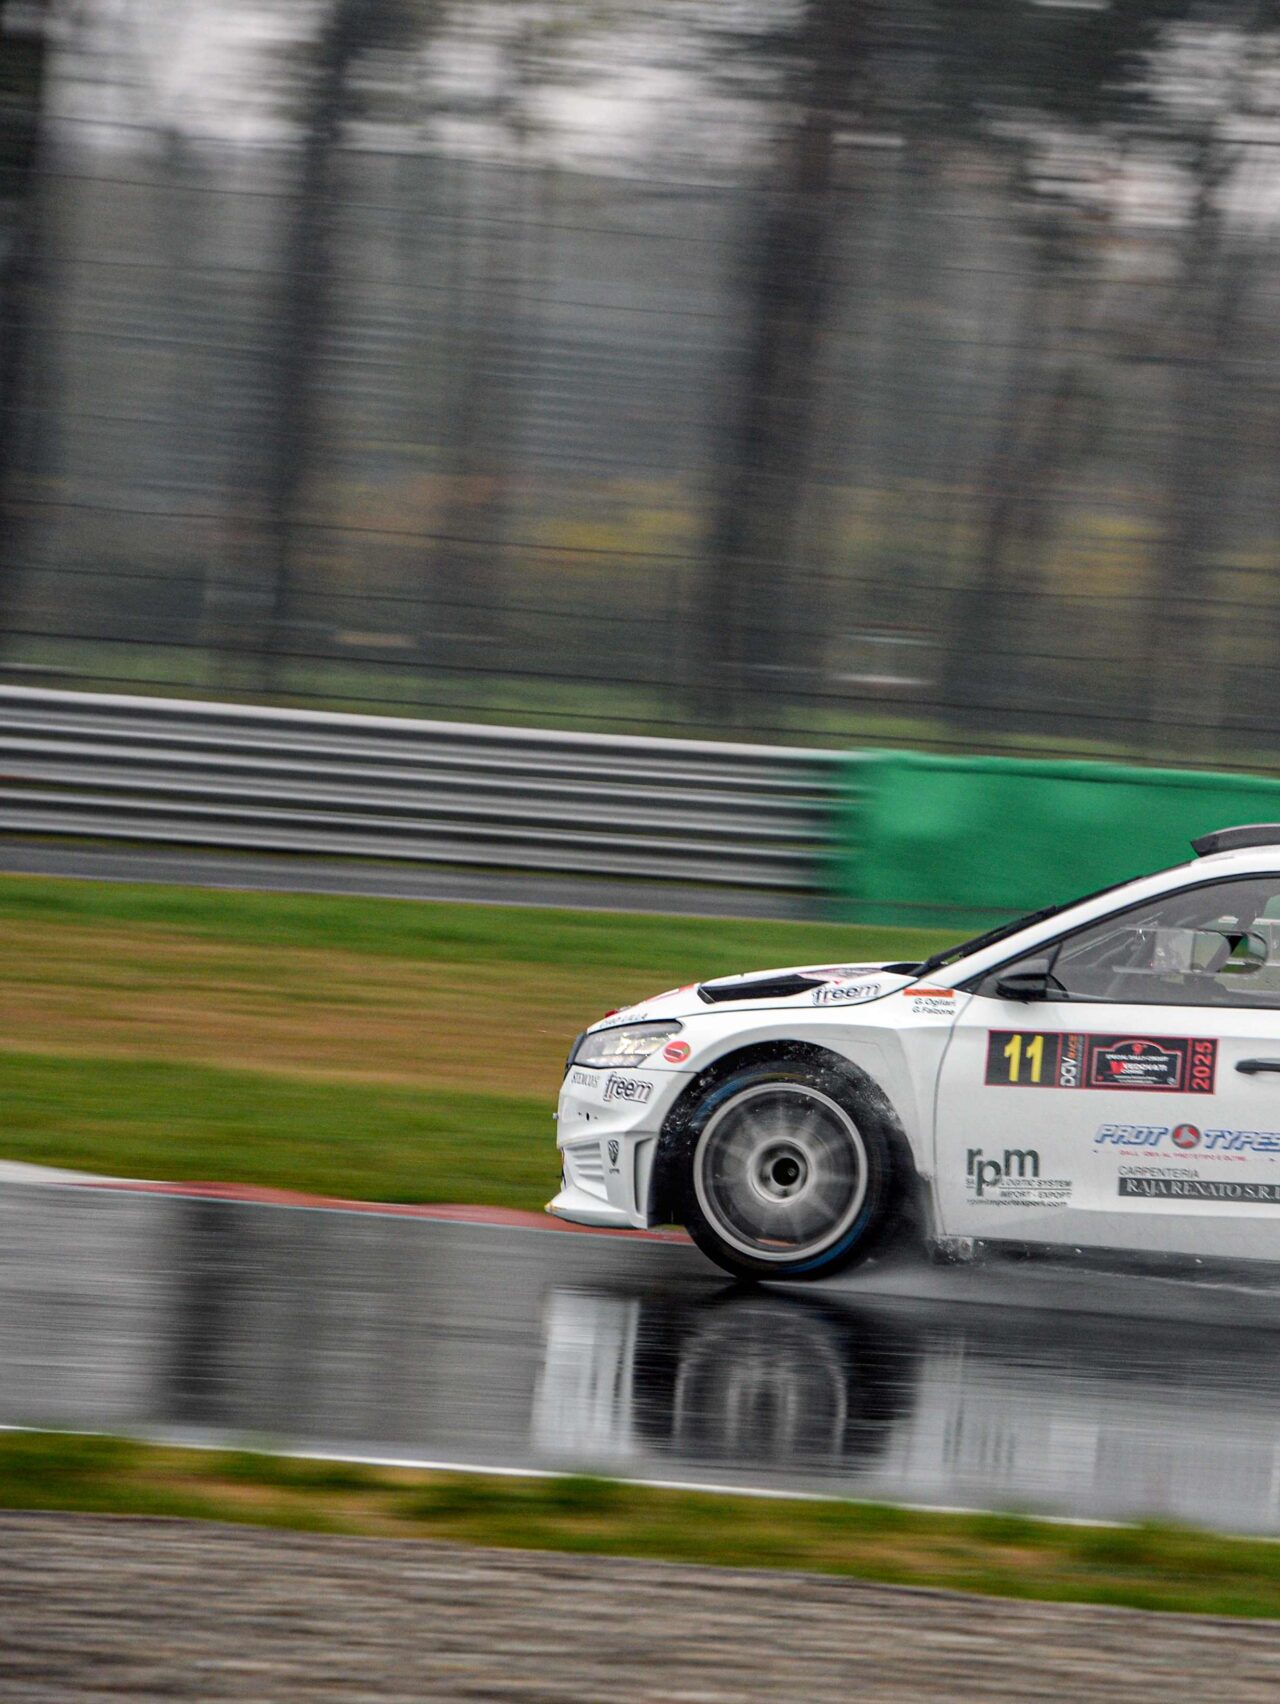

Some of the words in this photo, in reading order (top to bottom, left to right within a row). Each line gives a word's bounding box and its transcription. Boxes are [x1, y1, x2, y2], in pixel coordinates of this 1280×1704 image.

[813, 983, 881, 1006] freem
[1003, 1034, 1044, 1083] 11
[1191, 1041, 1213, 1090] 2025
[603, 1071, 654, 1103] freem
[966, 1148, 1040, 1197] rpm
[1118, 1165, 1200, 1179] CARPENTERIA
[1126, 1178, 1167, 1197] RAJA
[1170, 1180, 1242, 1198] RENATO
